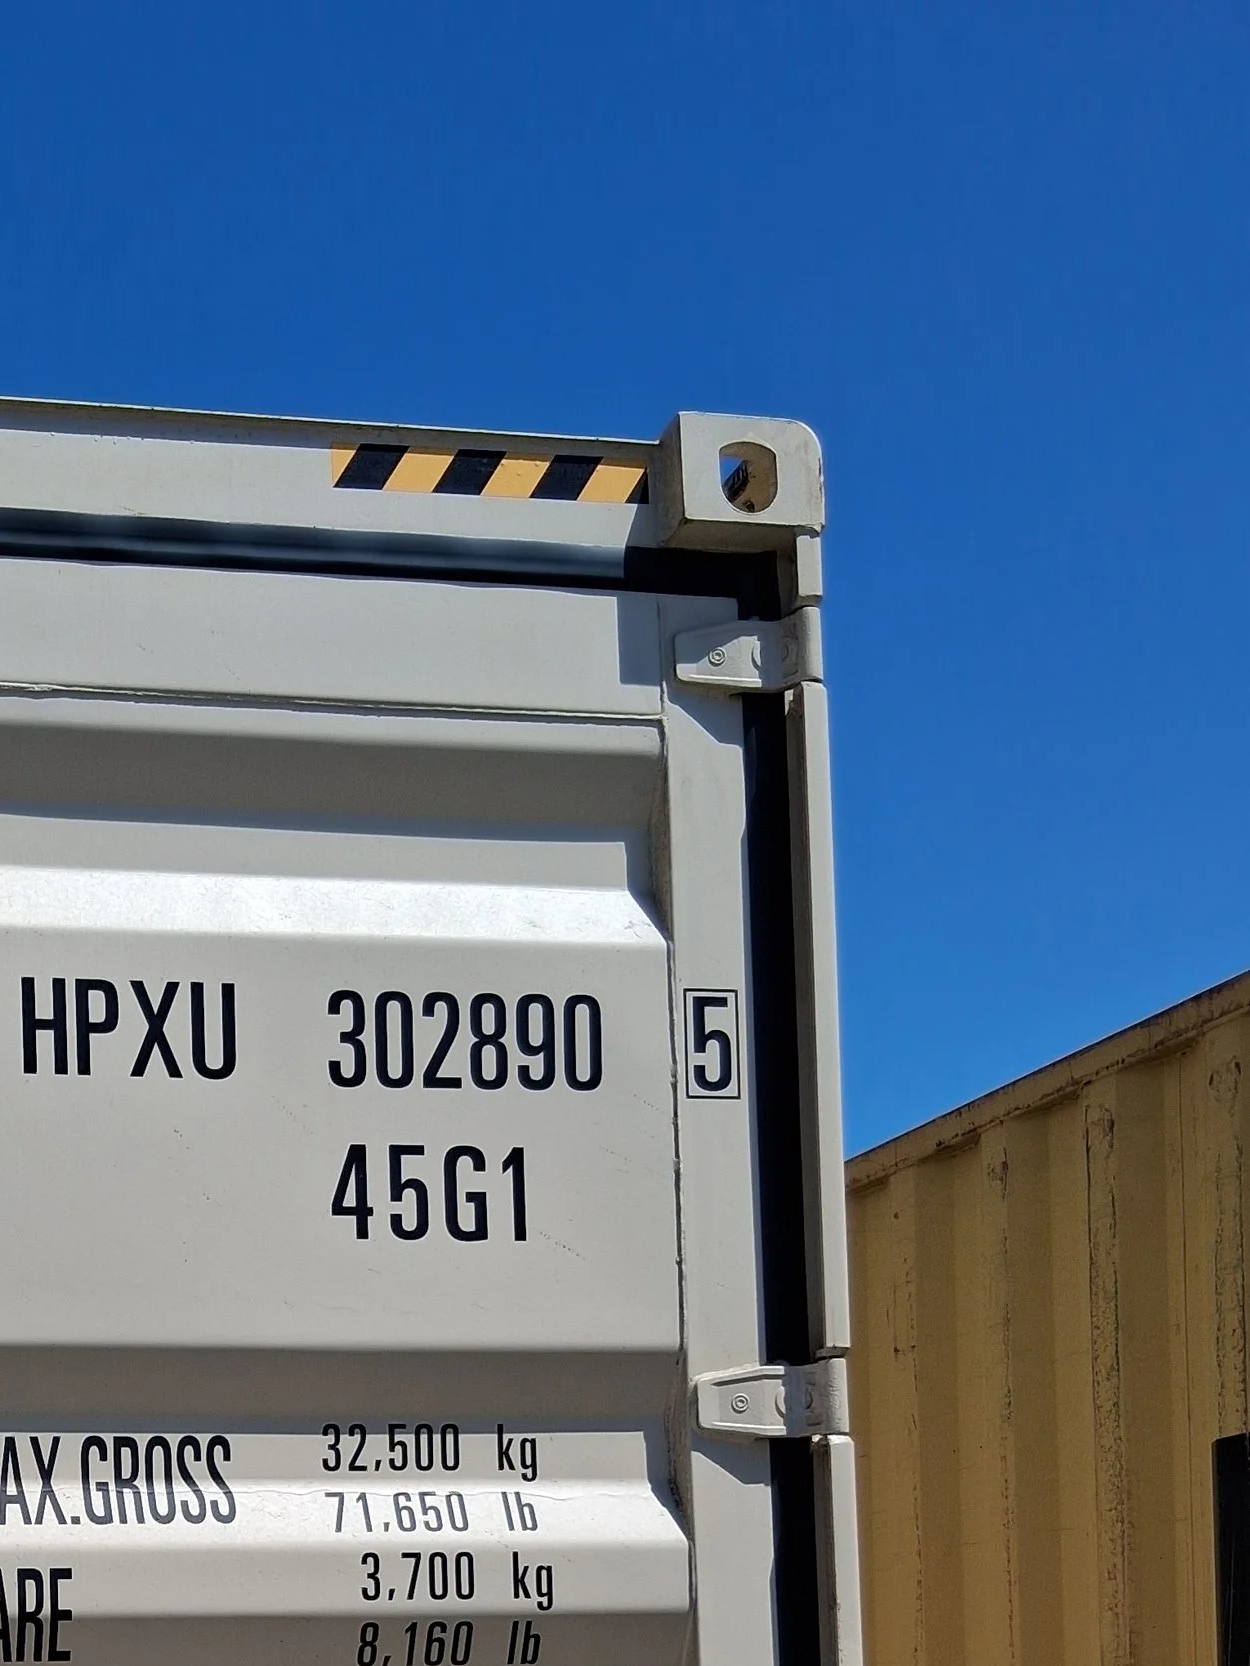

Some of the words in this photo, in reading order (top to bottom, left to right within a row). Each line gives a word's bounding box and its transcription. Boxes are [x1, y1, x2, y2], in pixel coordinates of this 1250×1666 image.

[20, 976, 237, 1081] HPXU
[327, 989, 603, 1092] 302890
[690, 994, 734, 1093] 5
[331, 1143, 527, 1243] 45G1
[321, 1423, 460, 1472] 32,500
[496, 1423, 538, 1483] kg
[324, 1490, 469, 1533] 71,650
[503, 1489, 541, 1533] lb
[360, 1551, 475, 1602] 3,700
[512, 1550, 554, 1612] kg
[506, 1619, 542, 1666] lb
